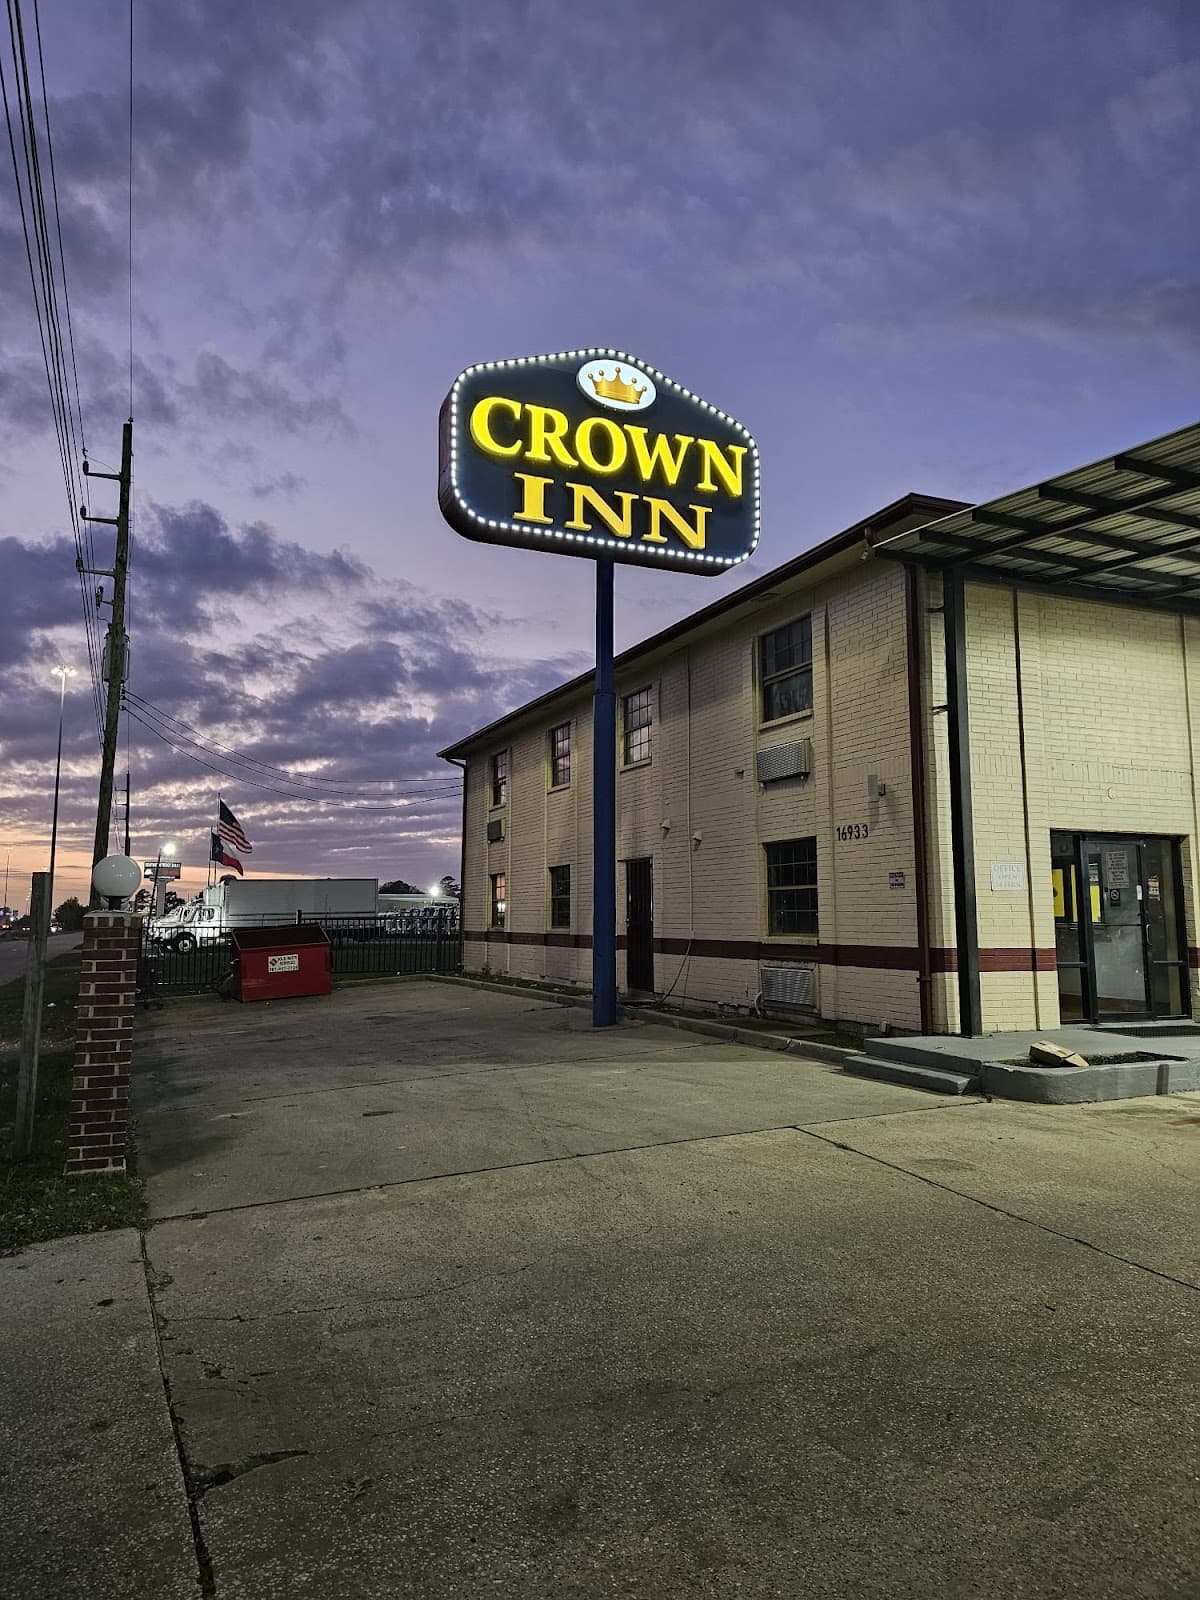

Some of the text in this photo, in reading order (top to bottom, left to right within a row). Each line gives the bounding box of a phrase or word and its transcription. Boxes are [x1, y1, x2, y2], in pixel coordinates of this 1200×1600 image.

[470, 397, 747, 497] CROWN
[512, 472, 713, 550] INN
[836, 824, 869, 841] 16933
